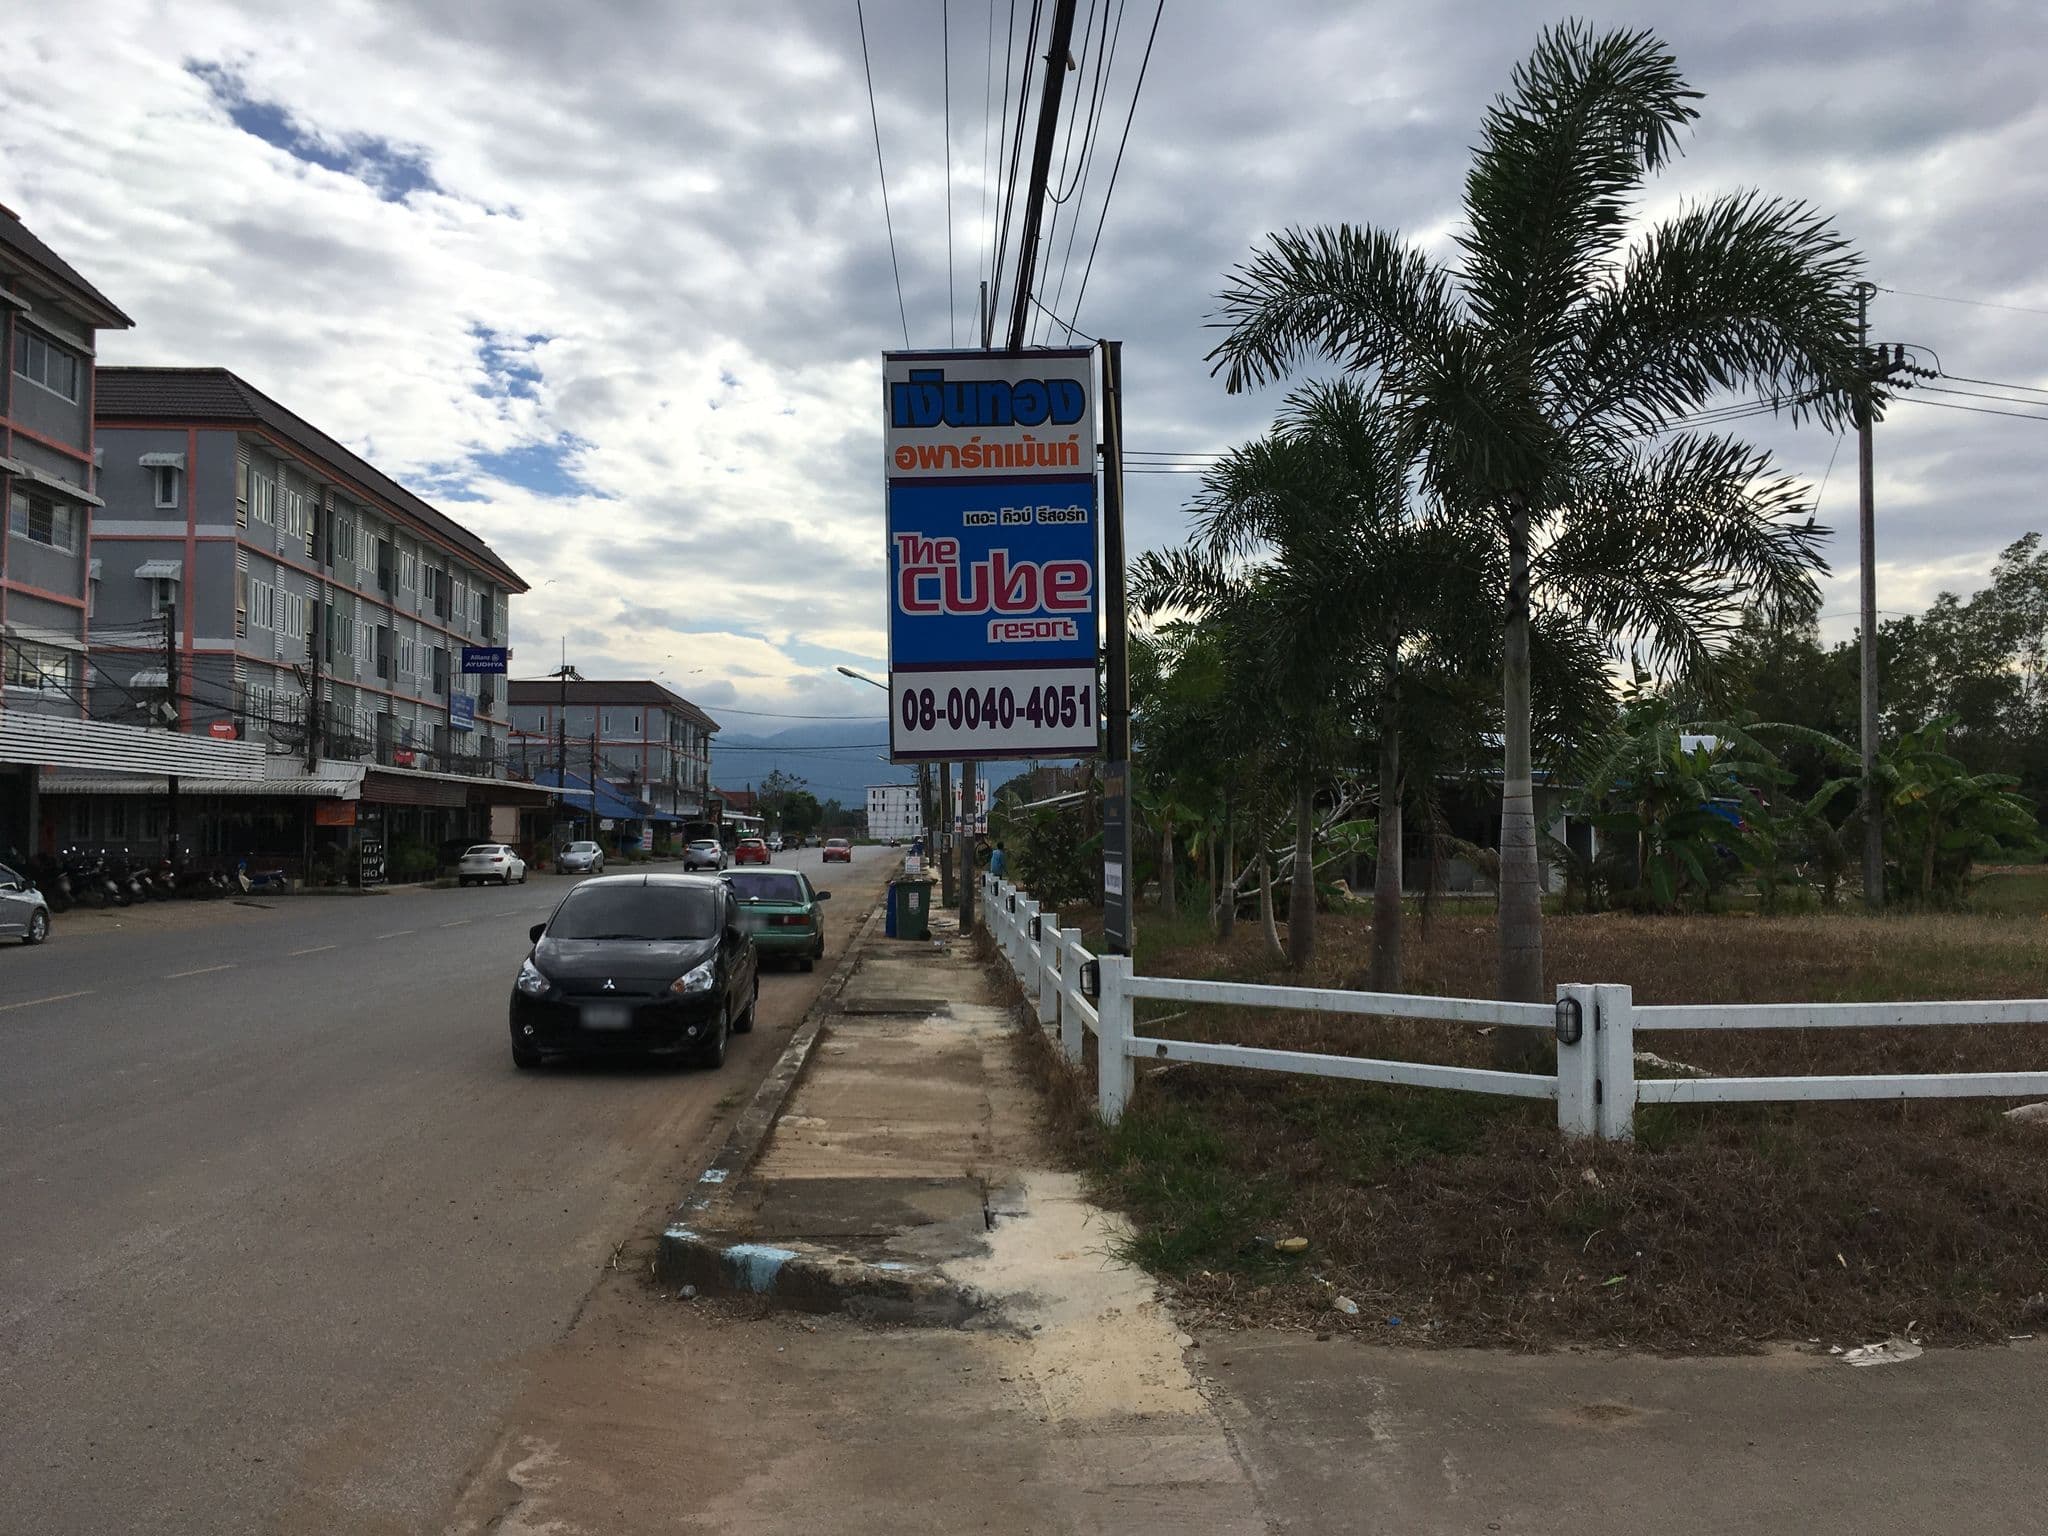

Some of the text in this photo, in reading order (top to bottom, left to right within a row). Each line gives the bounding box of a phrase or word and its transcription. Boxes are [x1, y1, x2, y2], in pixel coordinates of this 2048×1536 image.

[891, 369, 1086, 428] เงินทอง
[895, 434, 1080, 470] อพาร์ทเม้นท์
[965, 507, 1086, 524] เดอะ คิวบ์ รีสอร์ท
[898, 535, 957, 564] The
[992, 621, 1075, 639] resort
[902, 686, 1091, 730] 08-0040-4051
